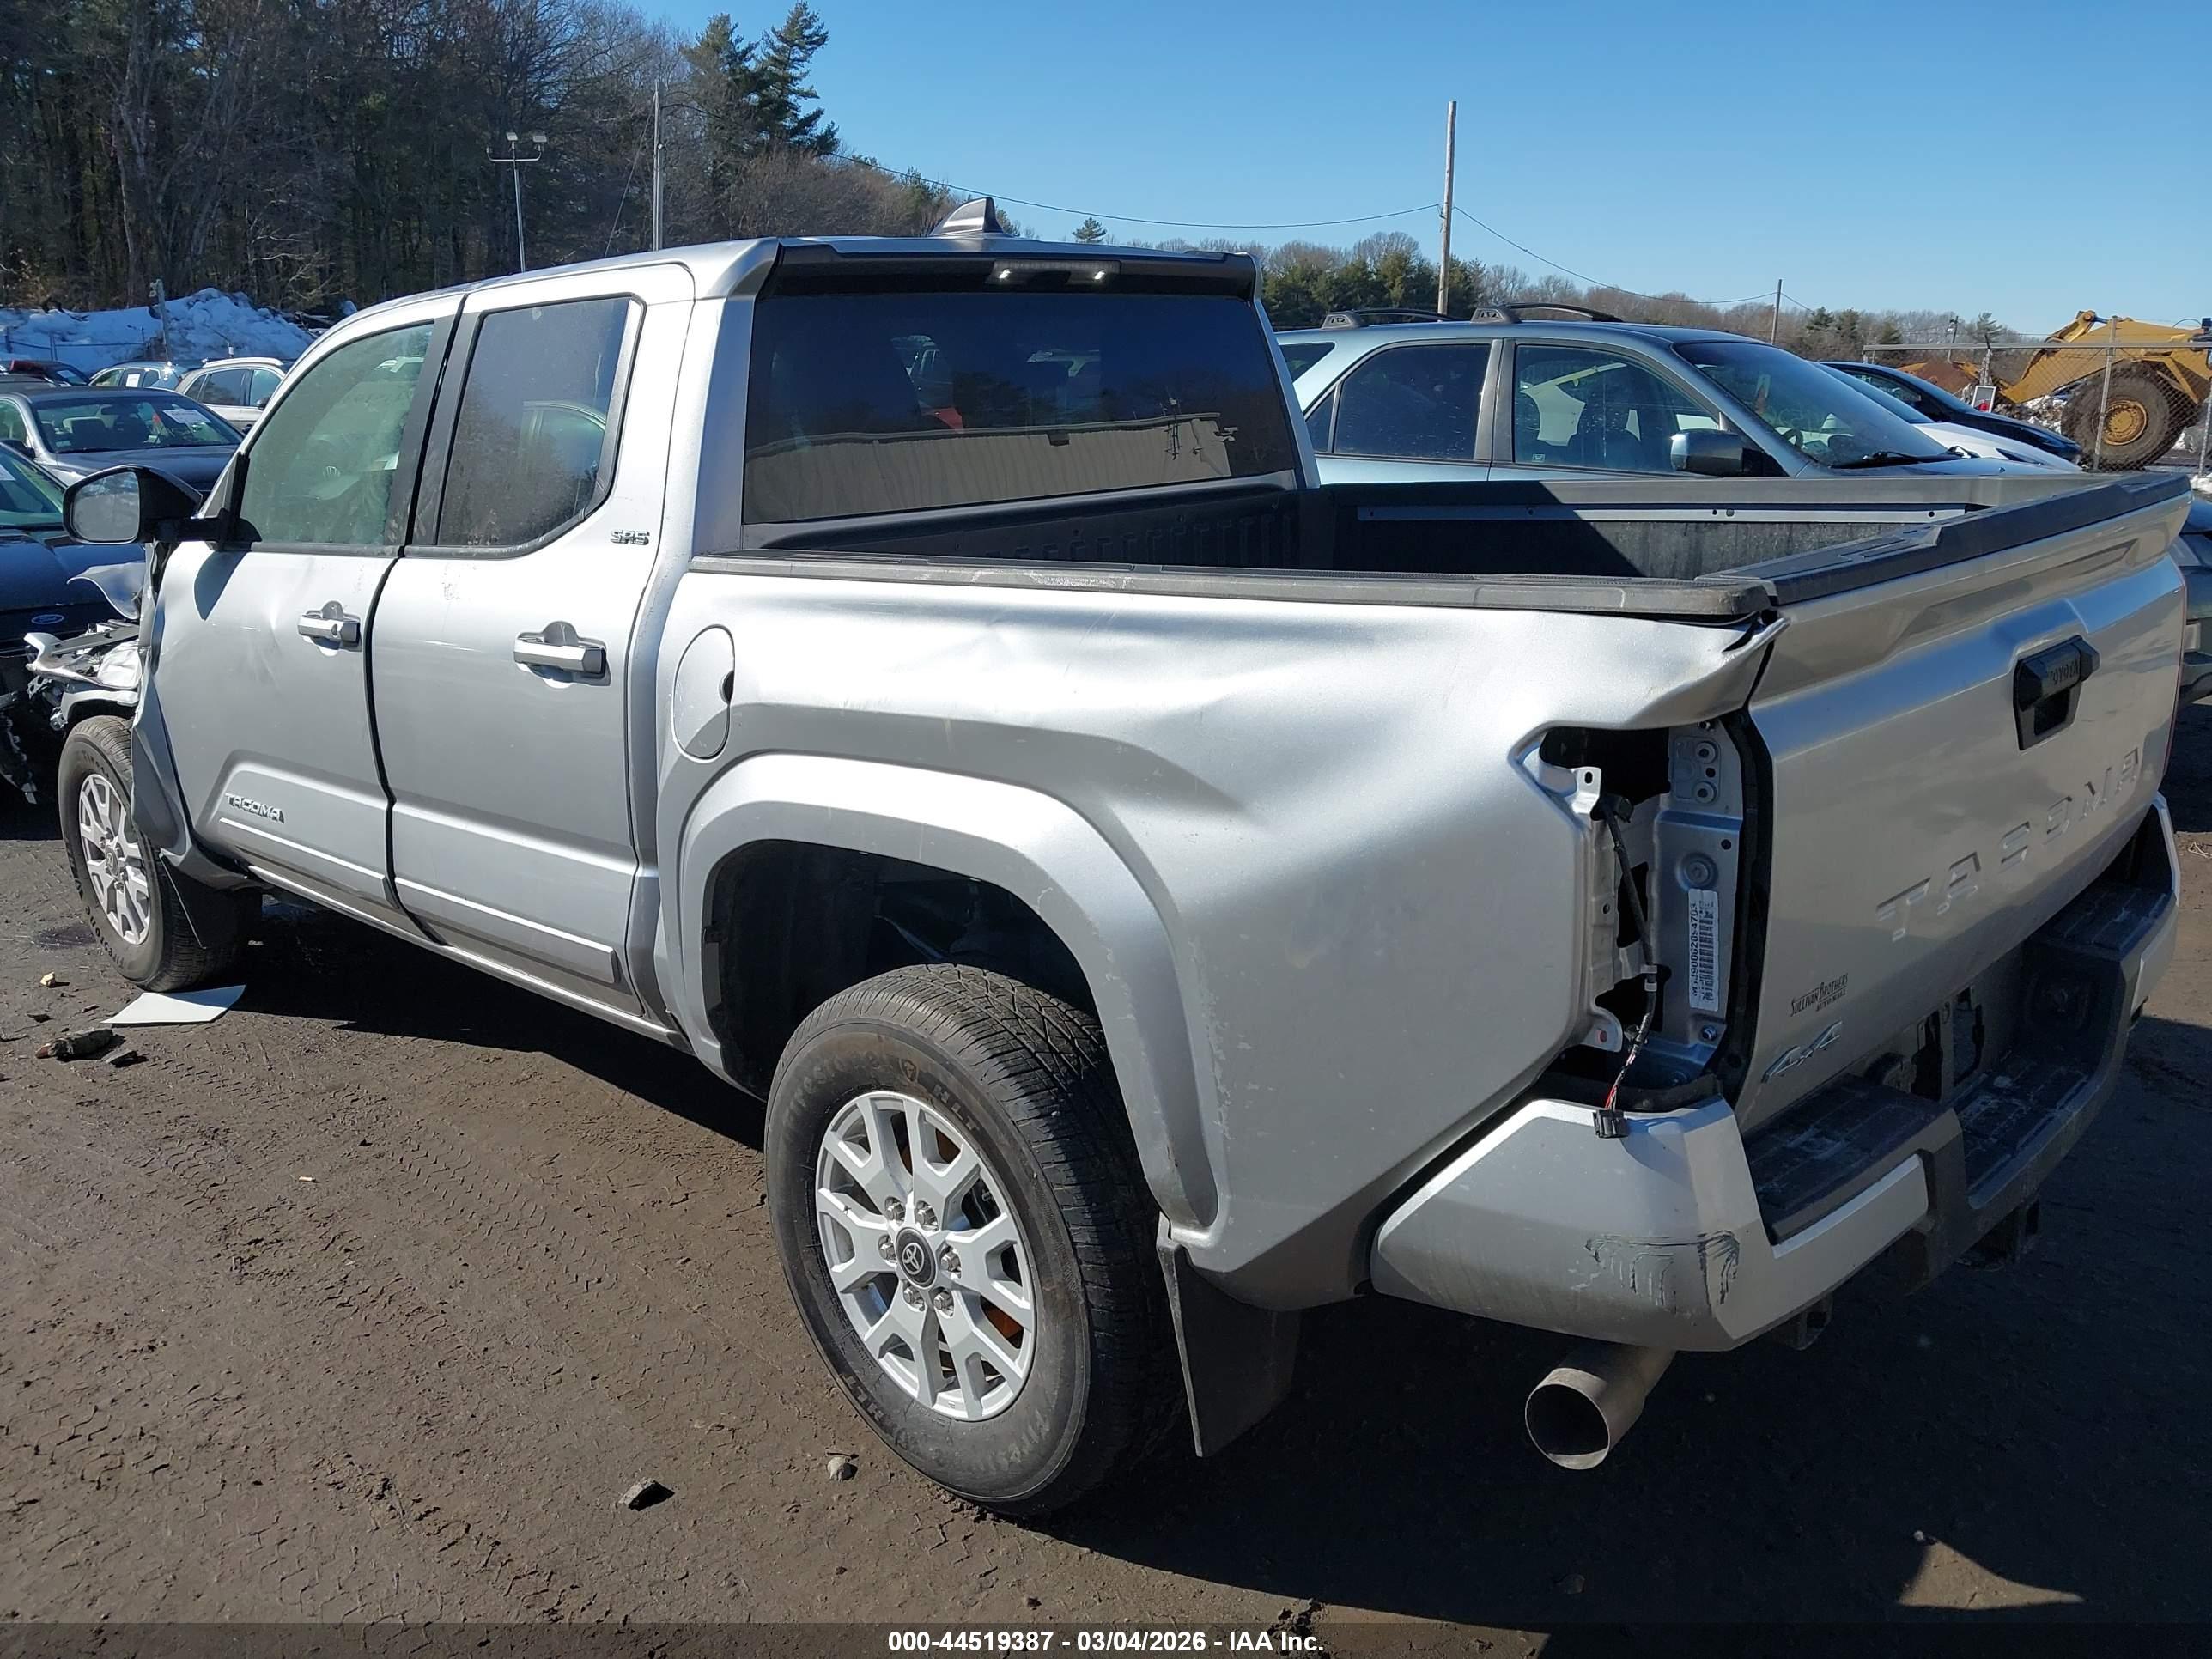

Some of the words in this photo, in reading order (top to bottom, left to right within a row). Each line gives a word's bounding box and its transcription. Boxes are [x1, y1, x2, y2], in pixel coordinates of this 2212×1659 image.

[611, 529, 650, 546] SR5
[225, 793, 284, 824] TACOMA
[1875, 747, 2141, 942] TACOMA
